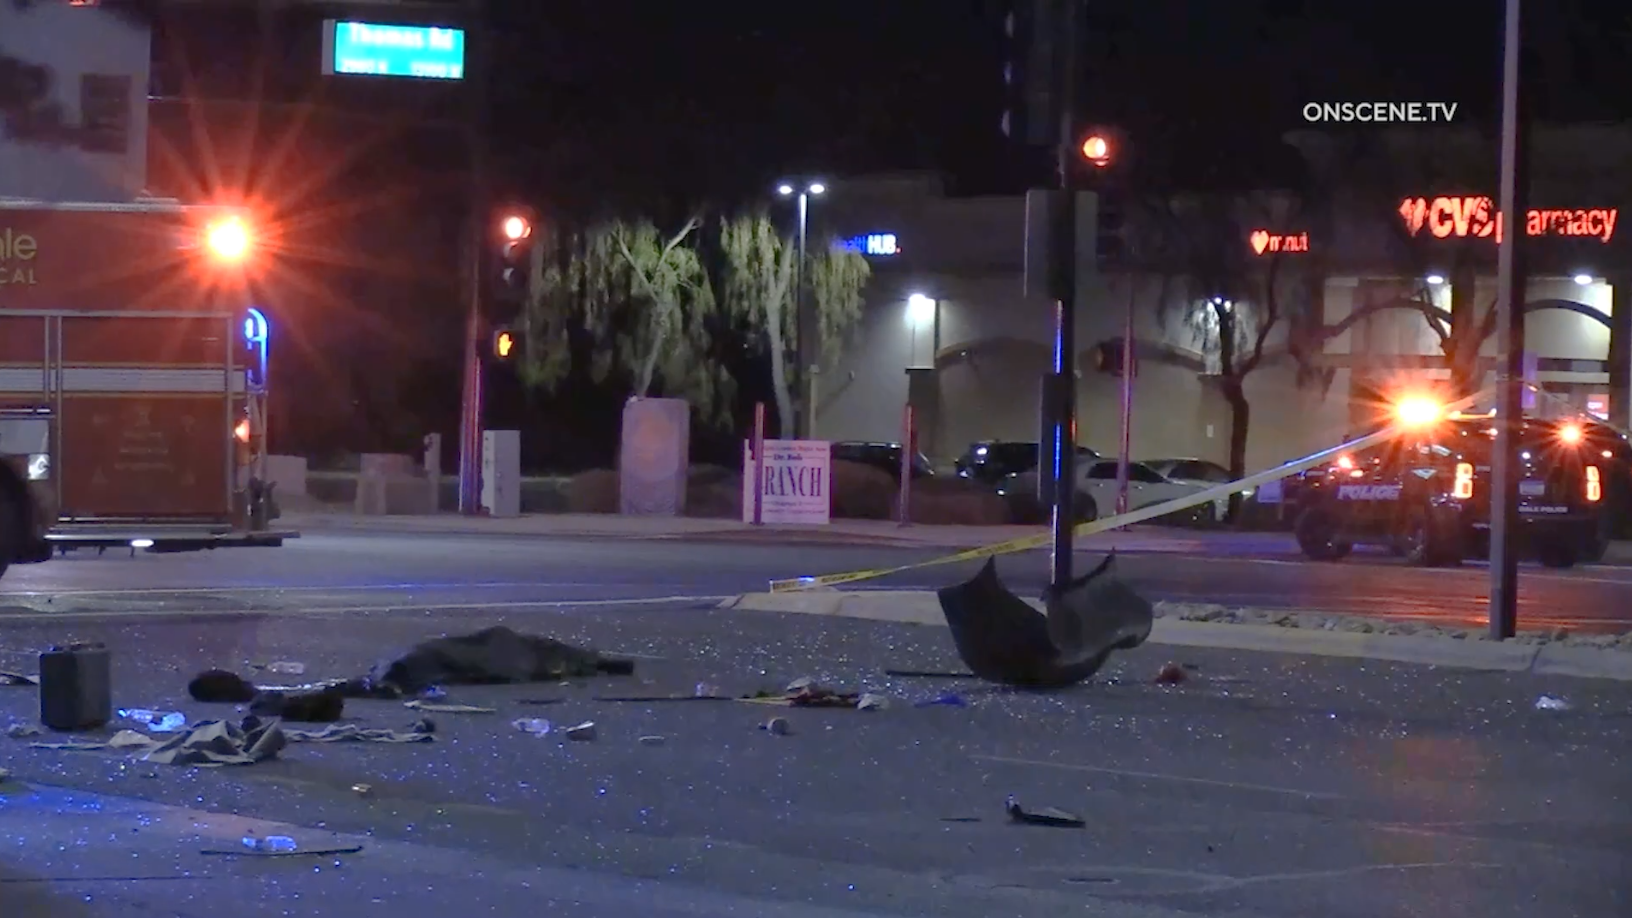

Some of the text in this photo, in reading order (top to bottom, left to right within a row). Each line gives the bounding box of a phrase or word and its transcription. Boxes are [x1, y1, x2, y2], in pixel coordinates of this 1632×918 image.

[348, 22, 454, 50] Thomas Rd
[1430, 196, 1494, 237] CVS
[758, 466, 822, 497] RANCH
[1337, 485, 1399, 500] POLICE
